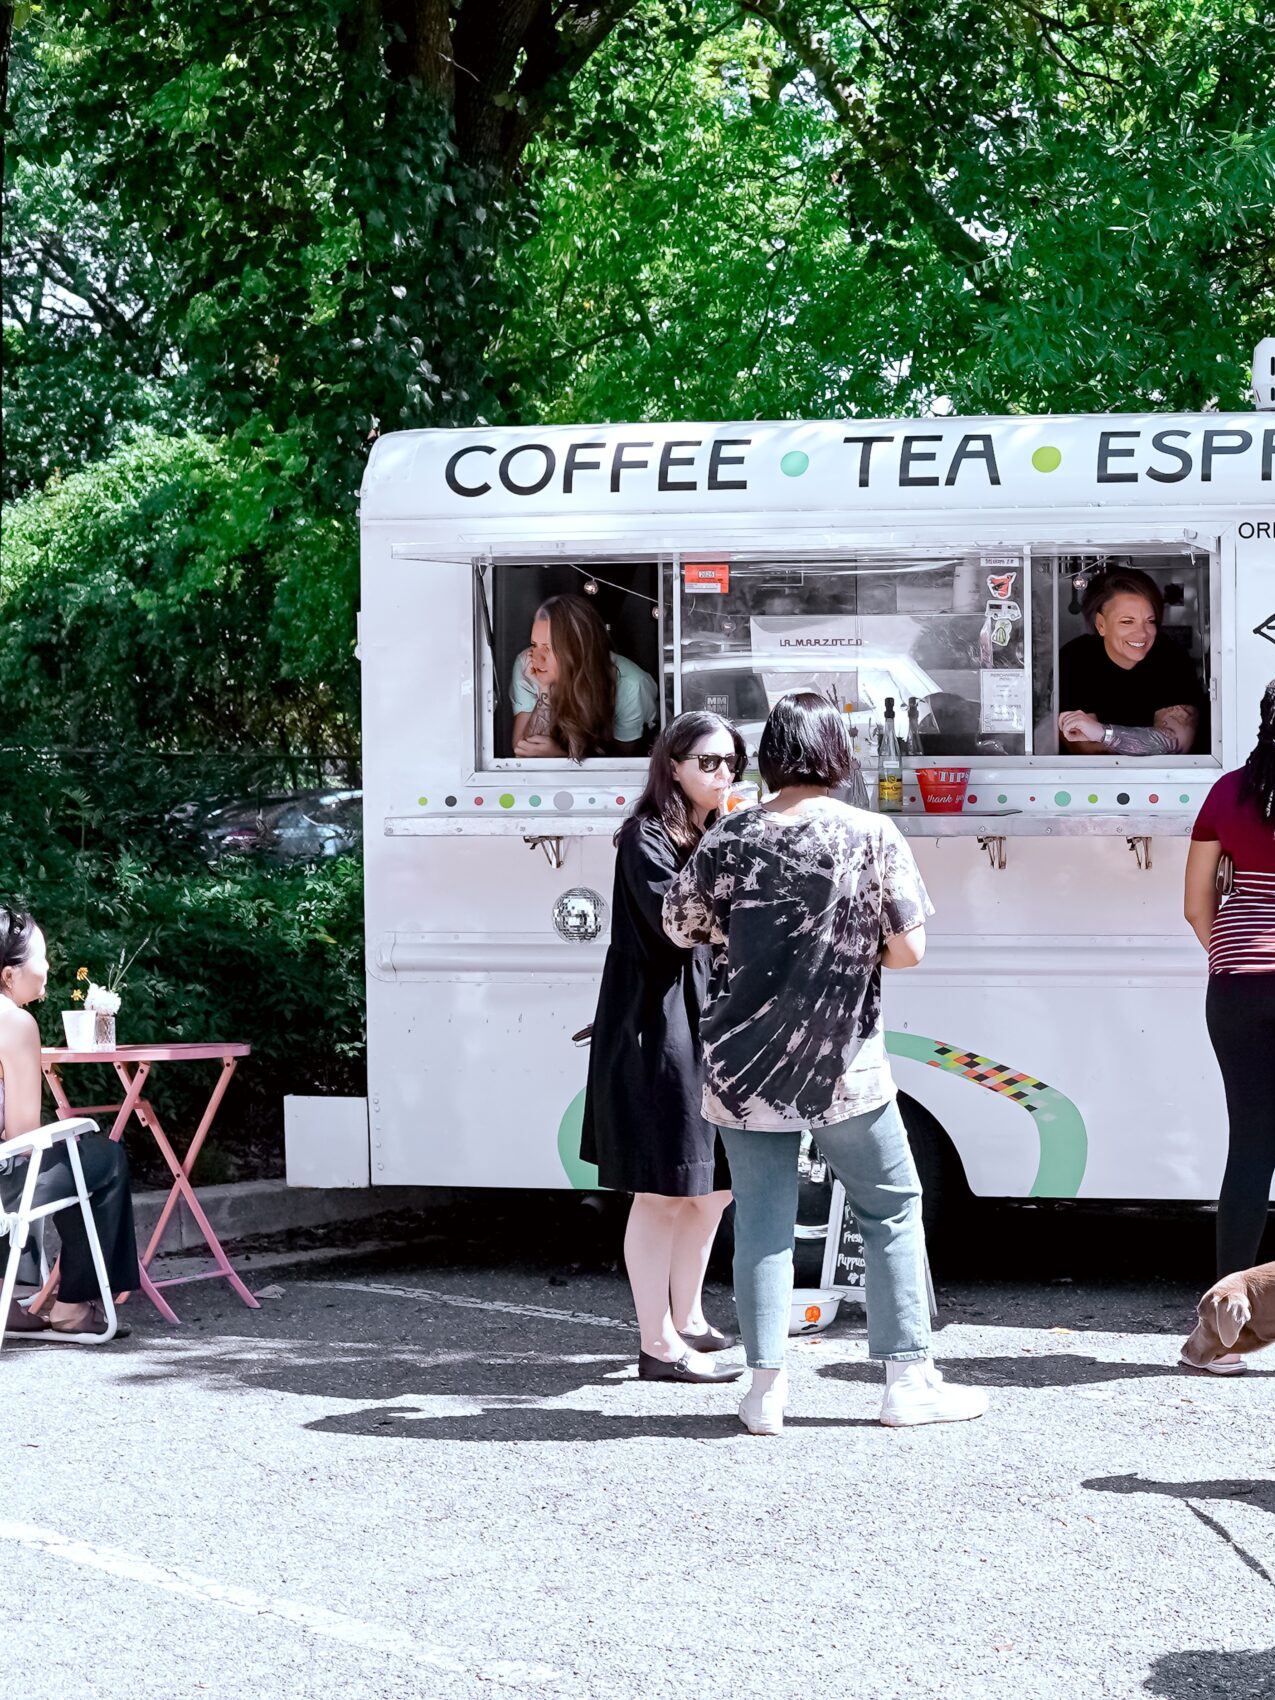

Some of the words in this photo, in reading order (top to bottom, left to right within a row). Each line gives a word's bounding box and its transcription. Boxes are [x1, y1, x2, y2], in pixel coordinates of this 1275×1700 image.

[446, 440, 751, 497] COFFEE
[844, 435, 1001, 487] TEA
[939, 771, 969, 783] TIPS
[927, 794, 953, 803] thank
